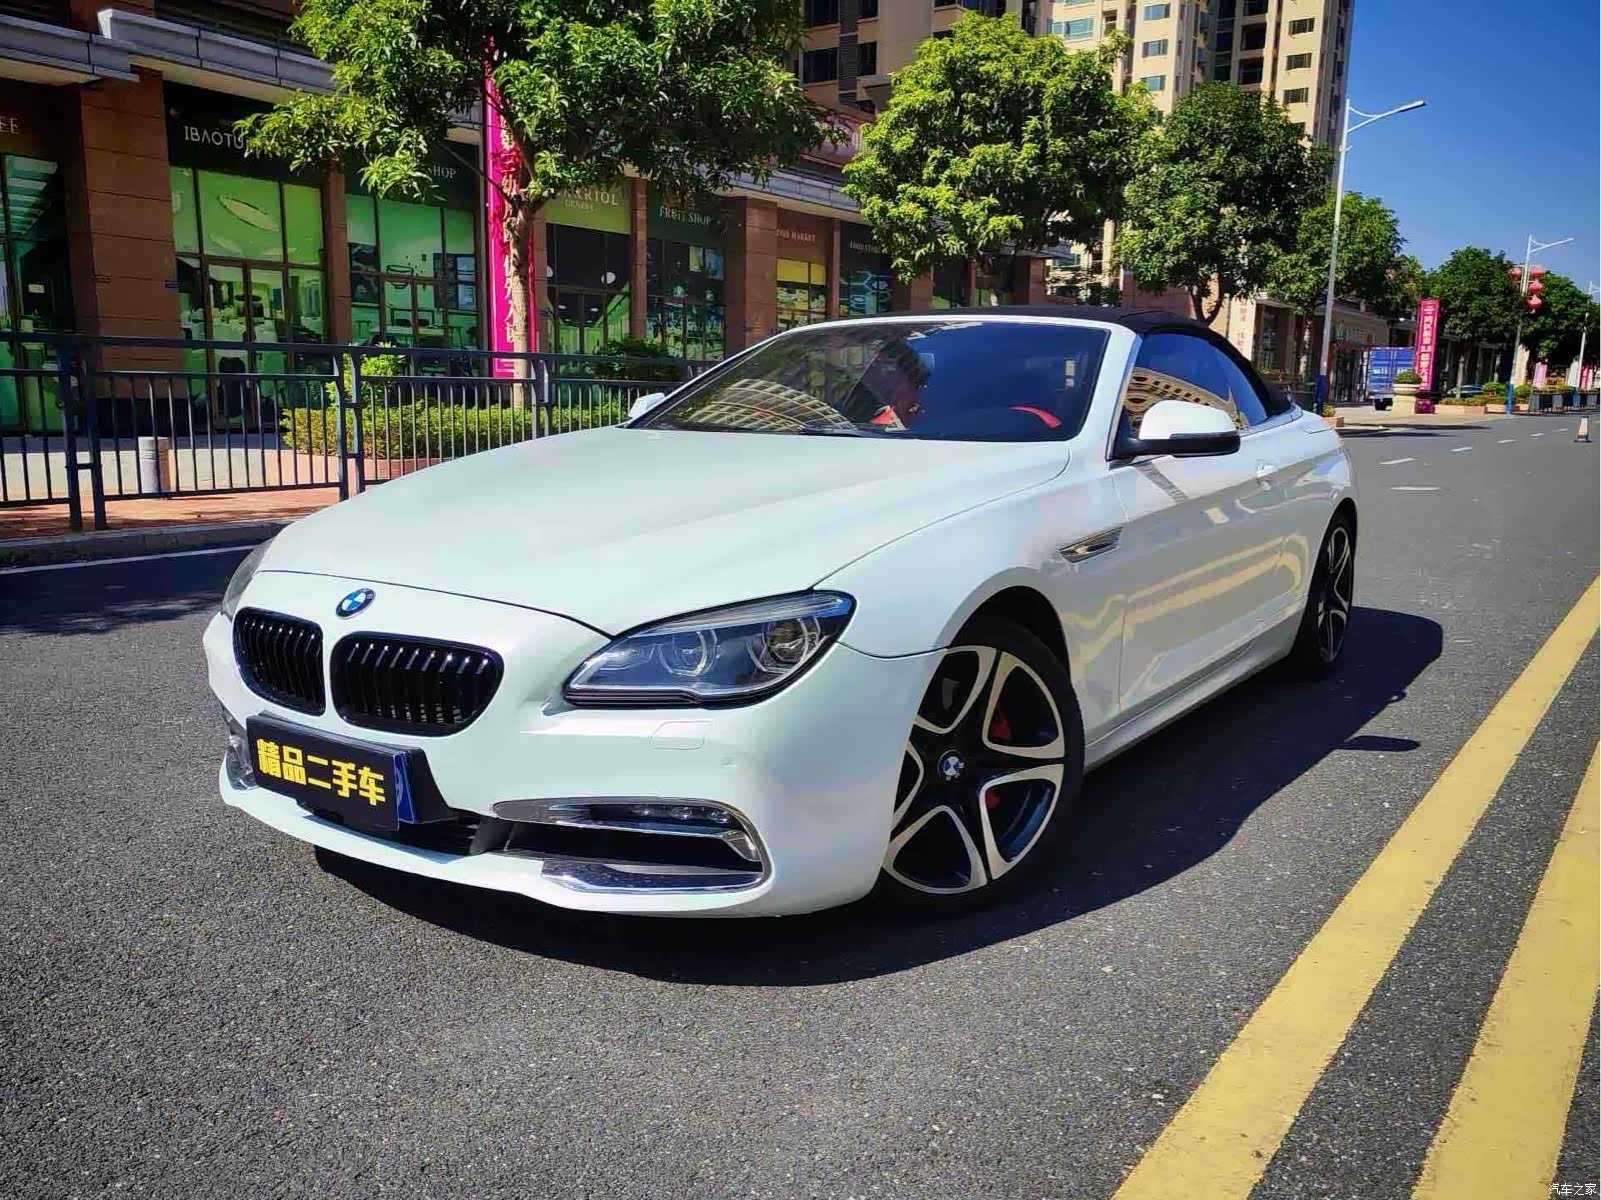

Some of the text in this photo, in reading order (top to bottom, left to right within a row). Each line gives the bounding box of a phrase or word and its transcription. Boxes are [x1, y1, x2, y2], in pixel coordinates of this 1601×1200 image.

[428, 164, 457, 179] HOP
[256, 738, 386, 807] 精品二手车
